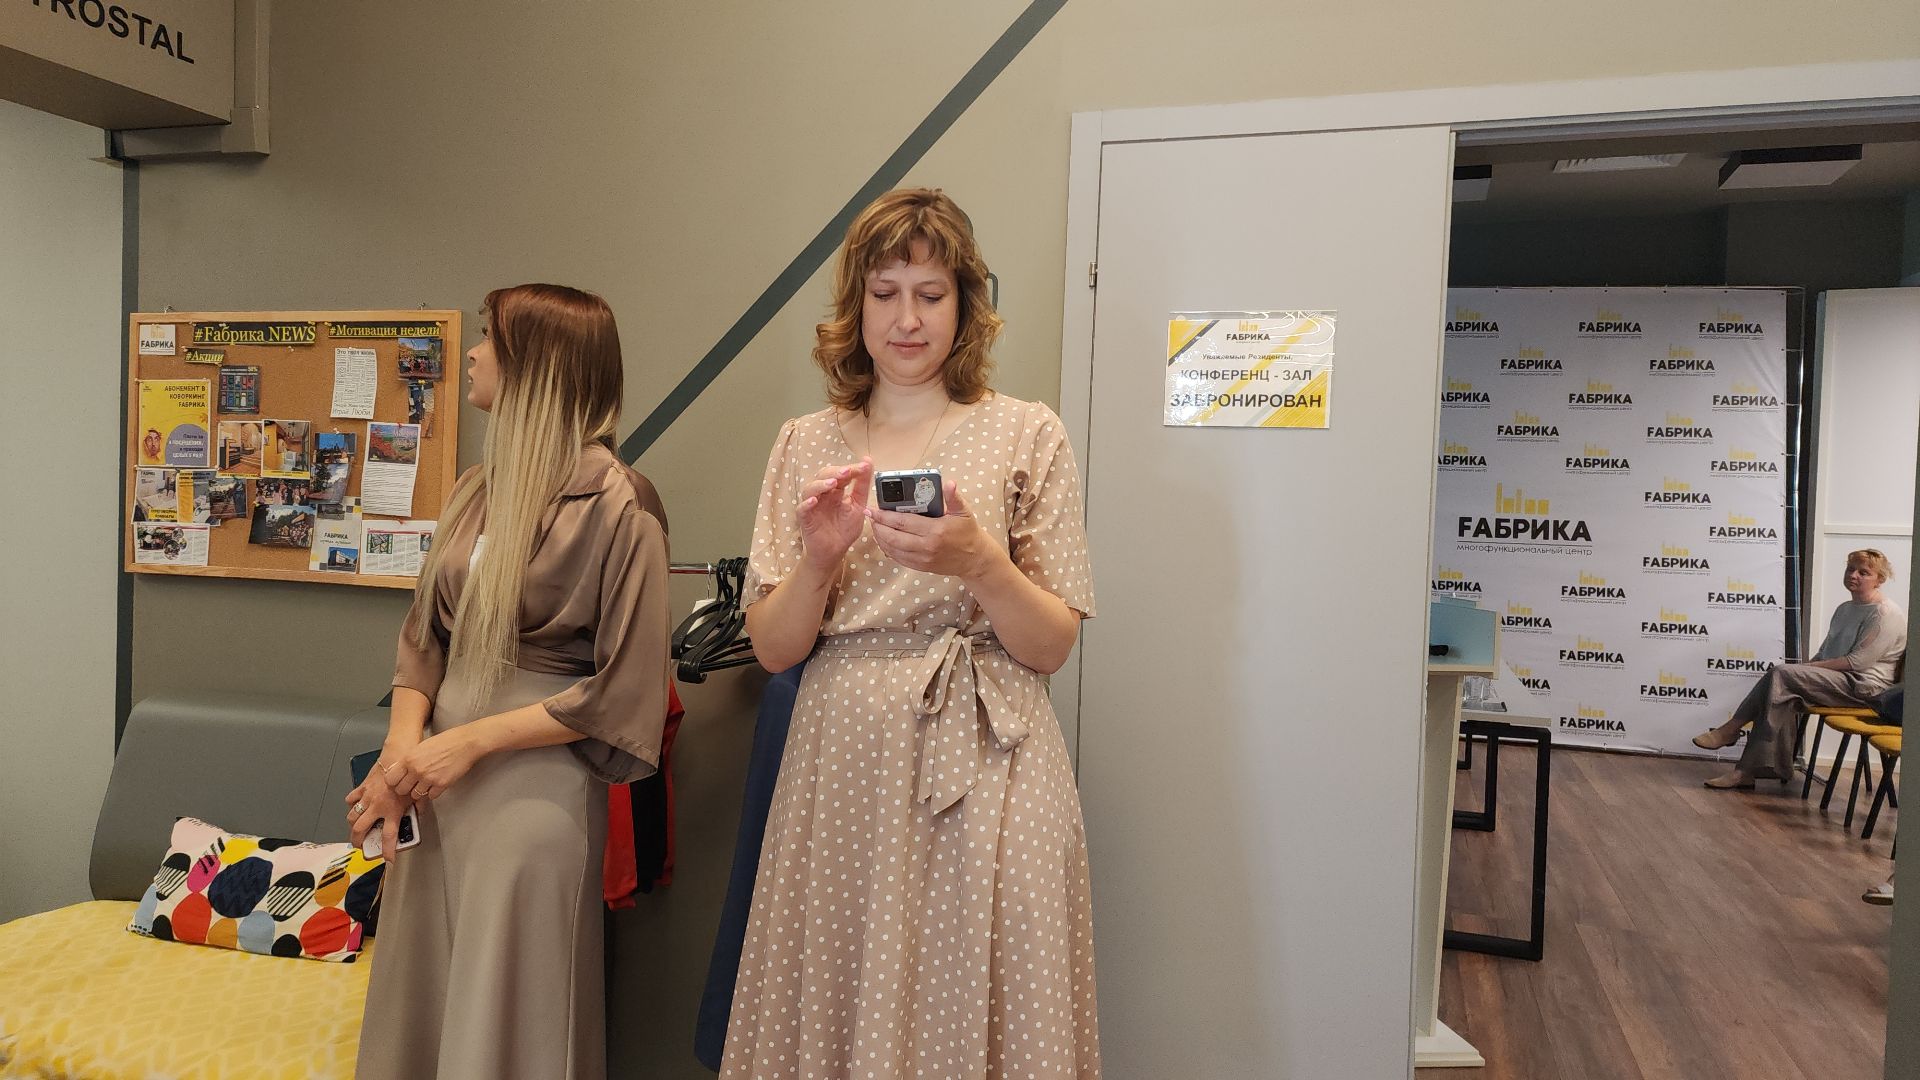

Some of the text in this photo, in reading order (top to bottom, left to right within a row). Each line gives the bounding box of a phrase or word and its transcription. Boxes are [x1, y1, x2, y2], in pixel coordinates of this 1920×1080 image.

[33, 0, 195, 64] ROSTAL
[329, 325, 440, 336] #Мотивация недели
[1445, 321, 1499, 332] АБРИКА
[1578, 321, 1642, 333] FАБРИКА
[1699, 322, 1763, 334] FАБРИКА
[268, 326, 317, 342] NEWS
[1226, 333, 1271, 341] FАБРИКА
[185, 351, 224, 363] #Акции
[1500, 358, 1563, 370] FАБРИКА
[1649, 359, 1715, 371] FАБРИКА
[1181, 369, 1269, 382] КОНФЕРЕНЦ
[1282, 369, 1312, 381] ЗАЛ
[1170, 393, 1322, 408] ЗАБРОНИРОВАН
[1442, 391, 1491, 403] БРИКА
[1568, 393, 1632, 404] FАБРИКА
[1712, 394, 1779, 408] FАБРИКА
[1497, 425, 1560, 437] FАБРИКА
[1647, 426, 1713, 438] FАБРИКА
[1438, 455, 1487, 466] БРИКА
[1565, 457, 1630, 469] FАБРИКА
[1710, 460, 1778, 472] FАБРИКА
[1644, 491, 1711, 504] FАБРИКА
[1458, 516, 1592, 544] FАБРИКА
[1709, 526, 1778, 539] FАБРИКА
[1456, 544, 1593, 556] многофункциональный центр
[1642, 556, 1710, 569] FАБРИКА
[1432, 580, 1482, 592] АБРИКА
[1561, 585, 1626, 598] FАБРИКА
[1707, 592, 1777, 605] FАБРИКА
[1501, 615, 1552, 628] БРИКА
[1641, 621, 1709, 635] FАБРИКА
[1559, 649, 1624, 663] FАБРИКА
[1640, 684, 1708, 699] FАБРИКА
[1559, 716, 1625, 732] FАБРИКА
